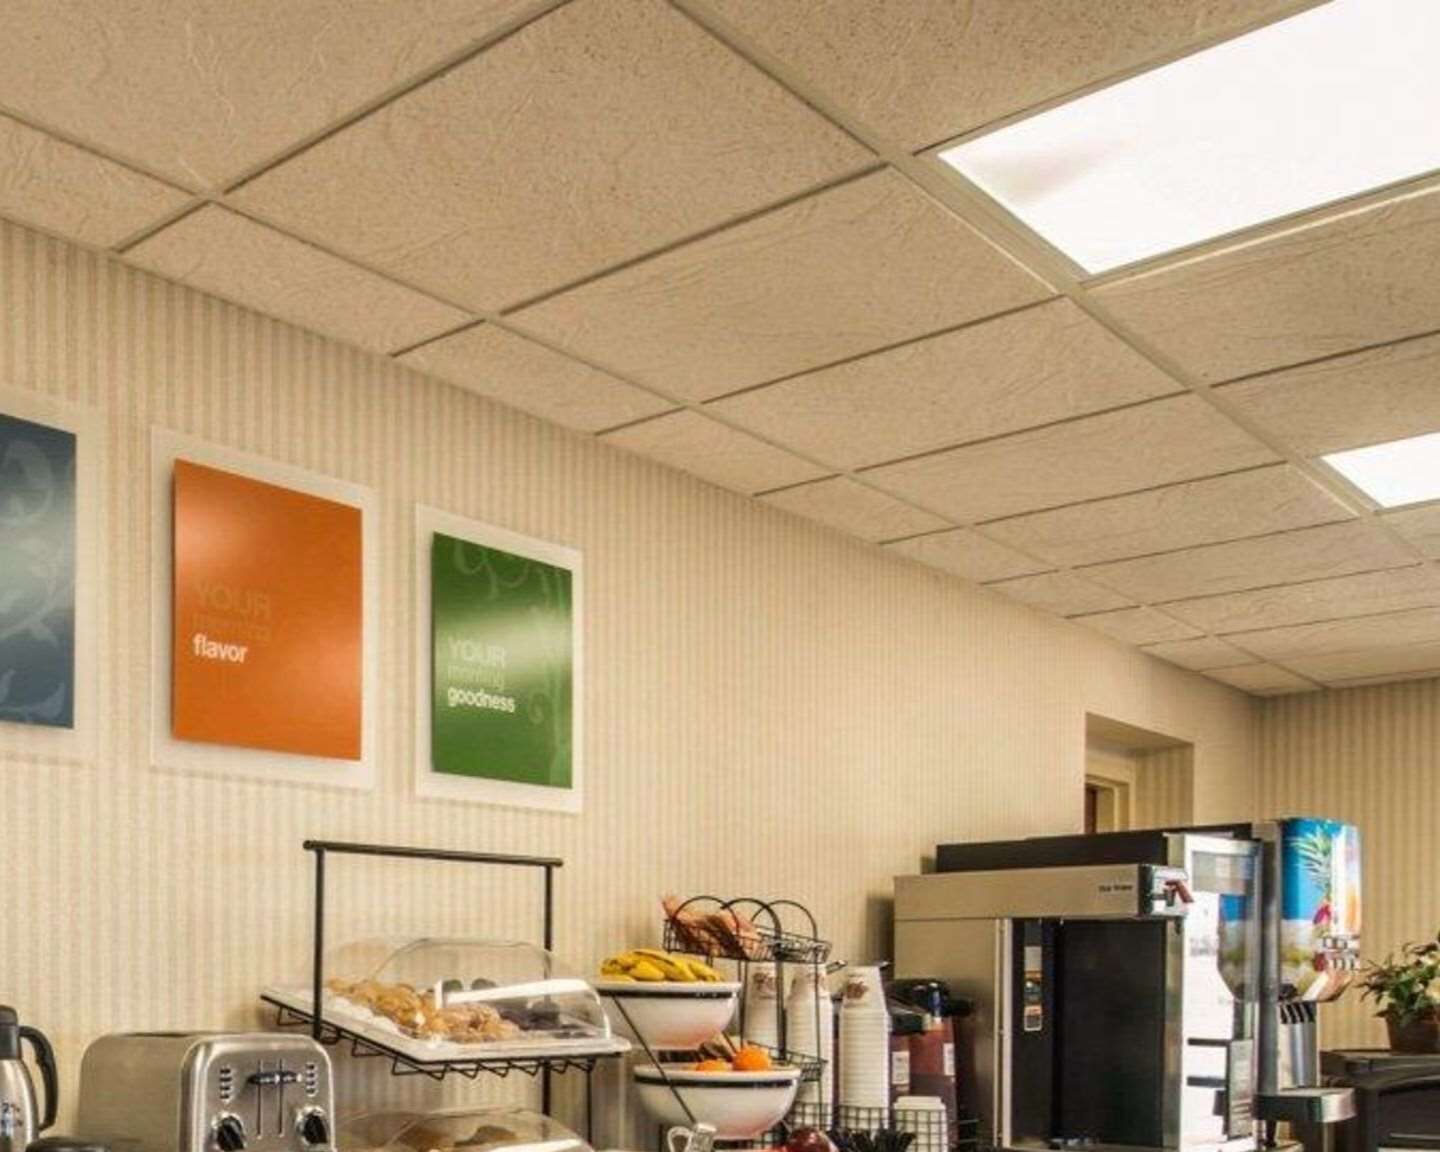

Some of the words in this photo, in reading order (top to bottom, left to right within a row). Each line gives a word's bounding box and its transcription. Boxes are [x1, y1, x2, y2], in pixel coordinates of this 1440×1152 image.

[192, 632, 249, 664] flavor
[448, 635, 507, 669] YOUR
[447, 686, 516, 713] goodness
